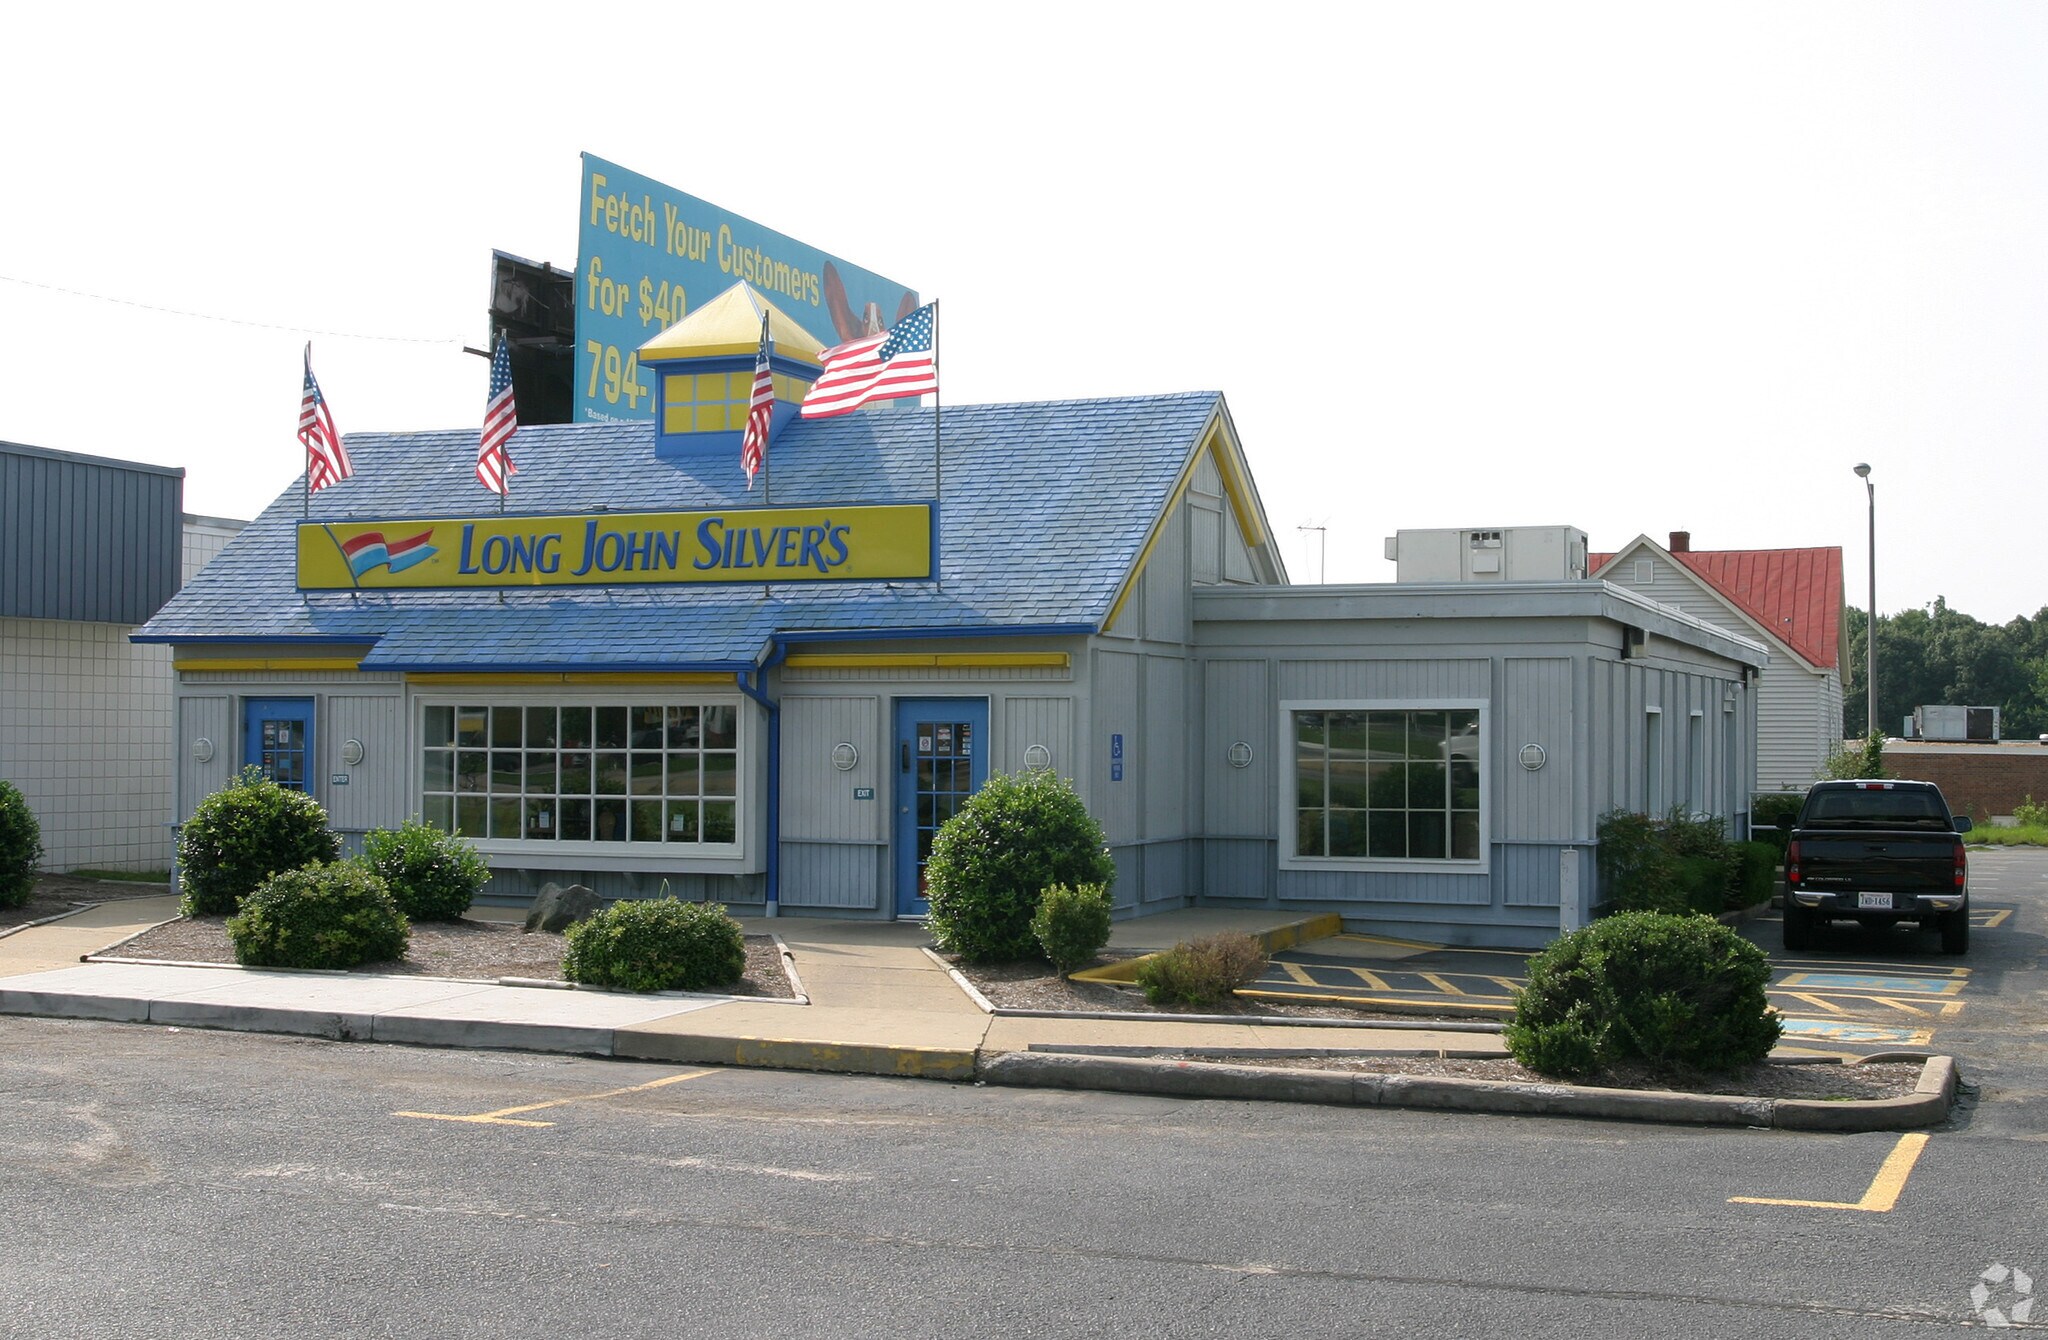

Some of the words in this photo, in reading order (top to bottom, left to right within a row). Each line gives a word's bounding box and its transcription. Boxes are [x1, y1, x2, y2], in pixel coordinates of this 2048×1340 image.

[590, 173, 656, 247] Fetch
[663, 202, 712, 264] Your
[717, 223, 820, 307] Customers
[587, 255, 630, 318] for
[587, 339, 655, 413] 794-
[458, 523, 562, 576] LONG
[571, 520, 681, 577] JOHN
[692, 516, 851, 574] SILVER'S
[857, 789, 871, 797] EXIT
